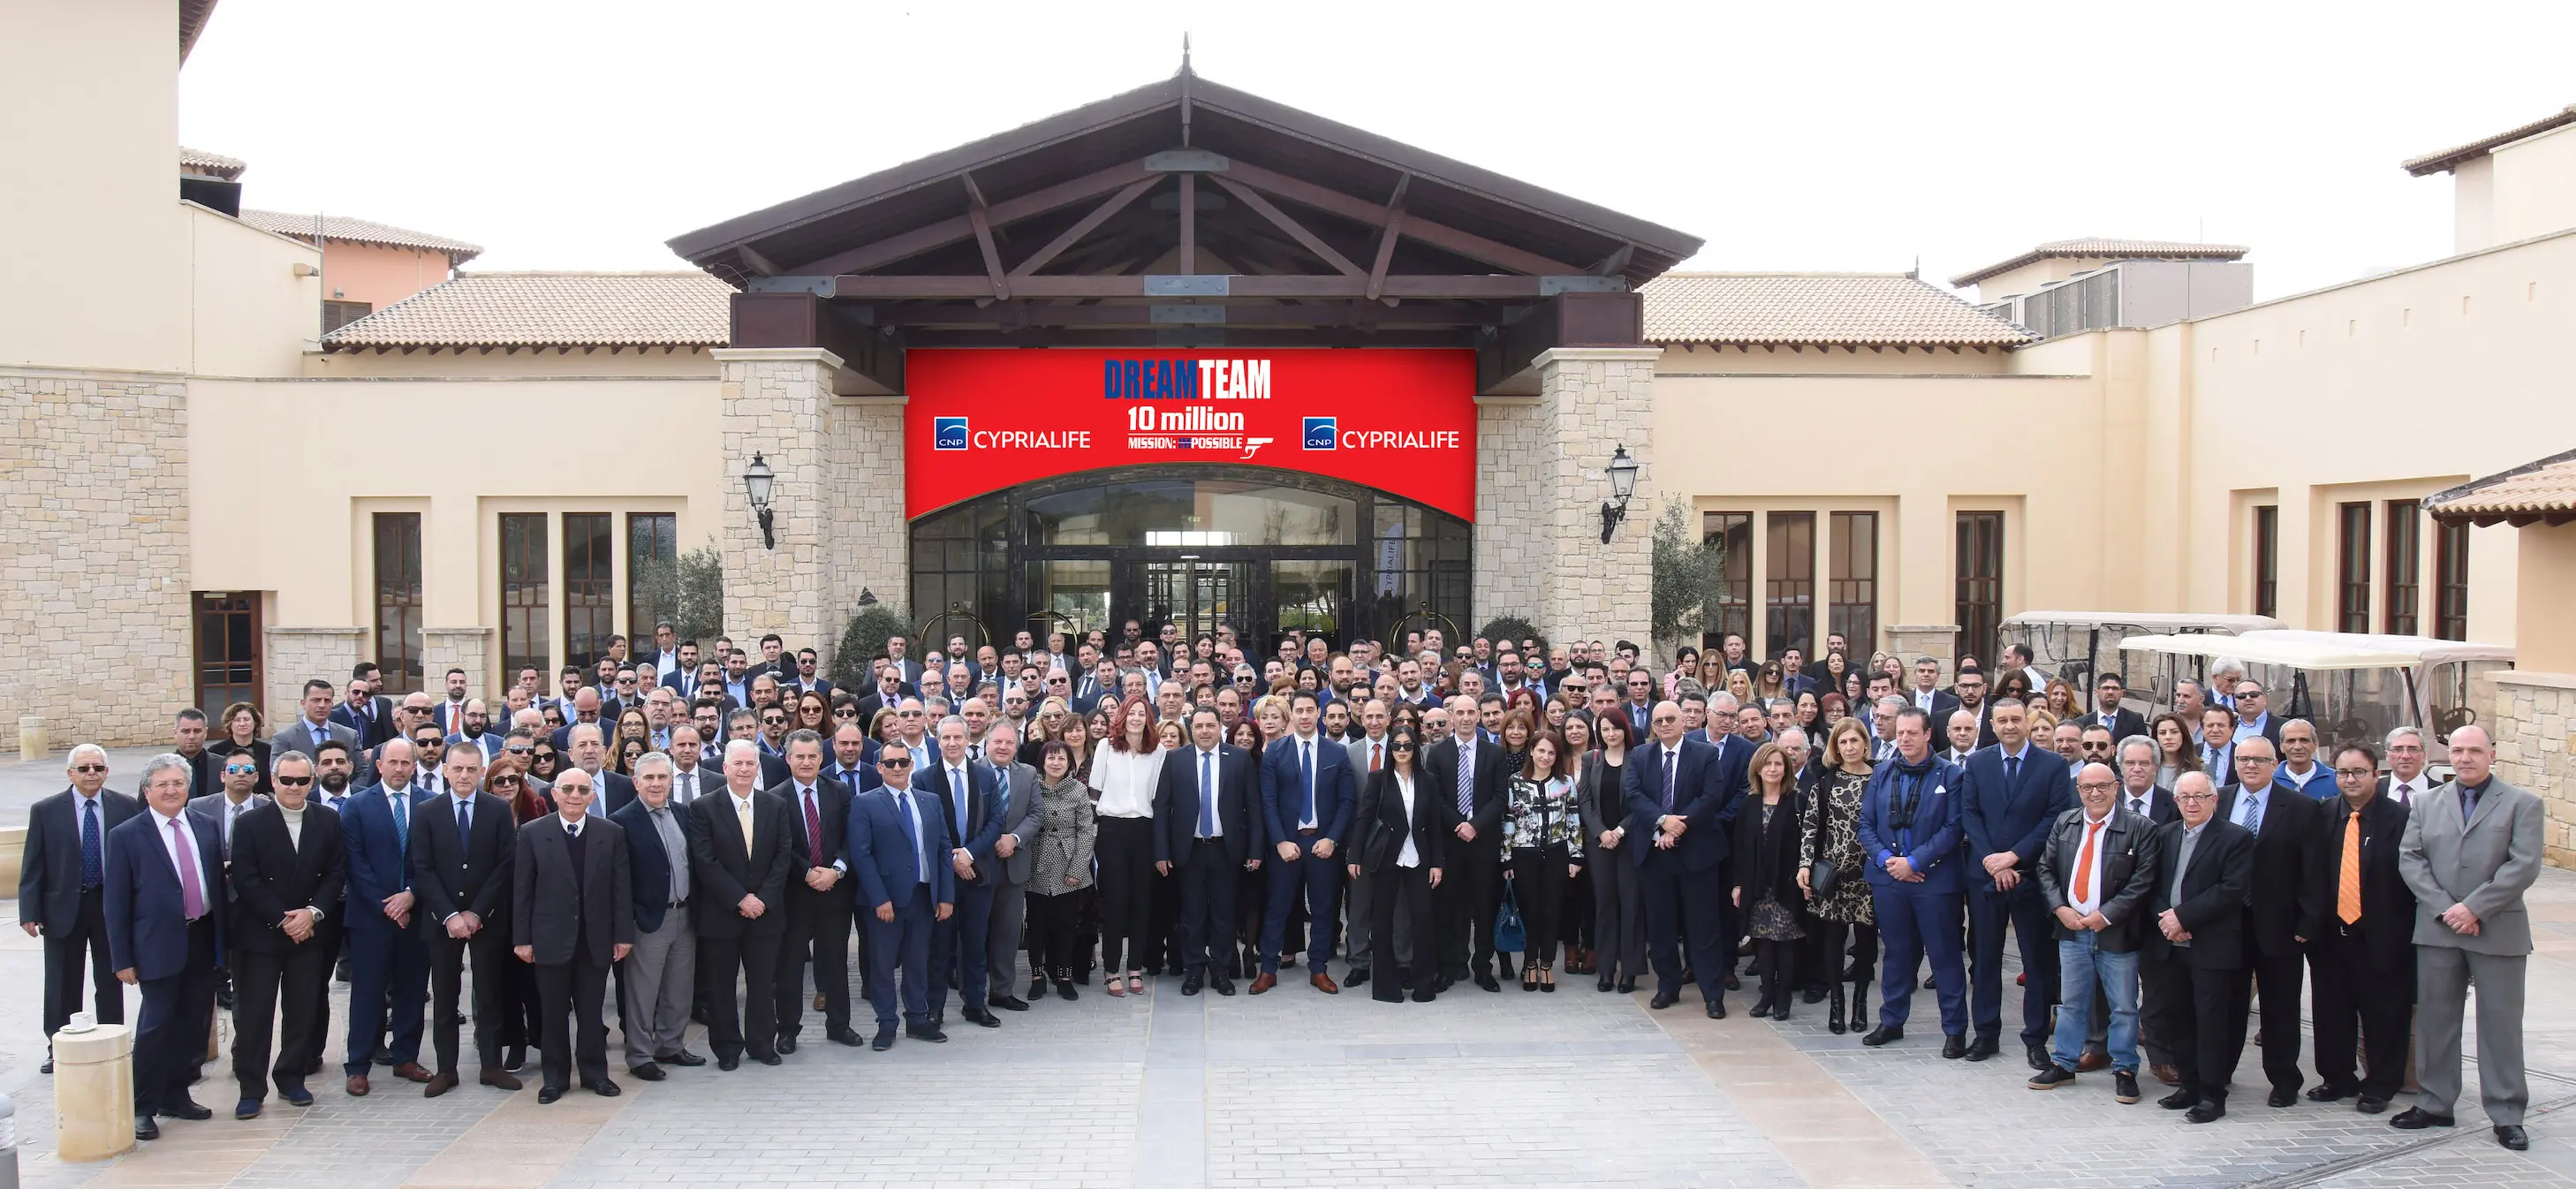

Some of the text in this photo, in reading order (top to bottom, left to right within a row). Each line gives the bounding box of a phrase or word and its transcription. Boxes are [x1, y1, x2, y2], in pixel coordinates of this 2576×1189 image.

[1128, 406, 1244, 430] 10 million
[974, 431, 1091, 449] CYPRIALIFE
[1128, 437, 1176, 449] MISSION:
[1342, 431, 1459, 449] CYPRIALIFE
[1385, 538, 1396, 592] YPRIALIFE
